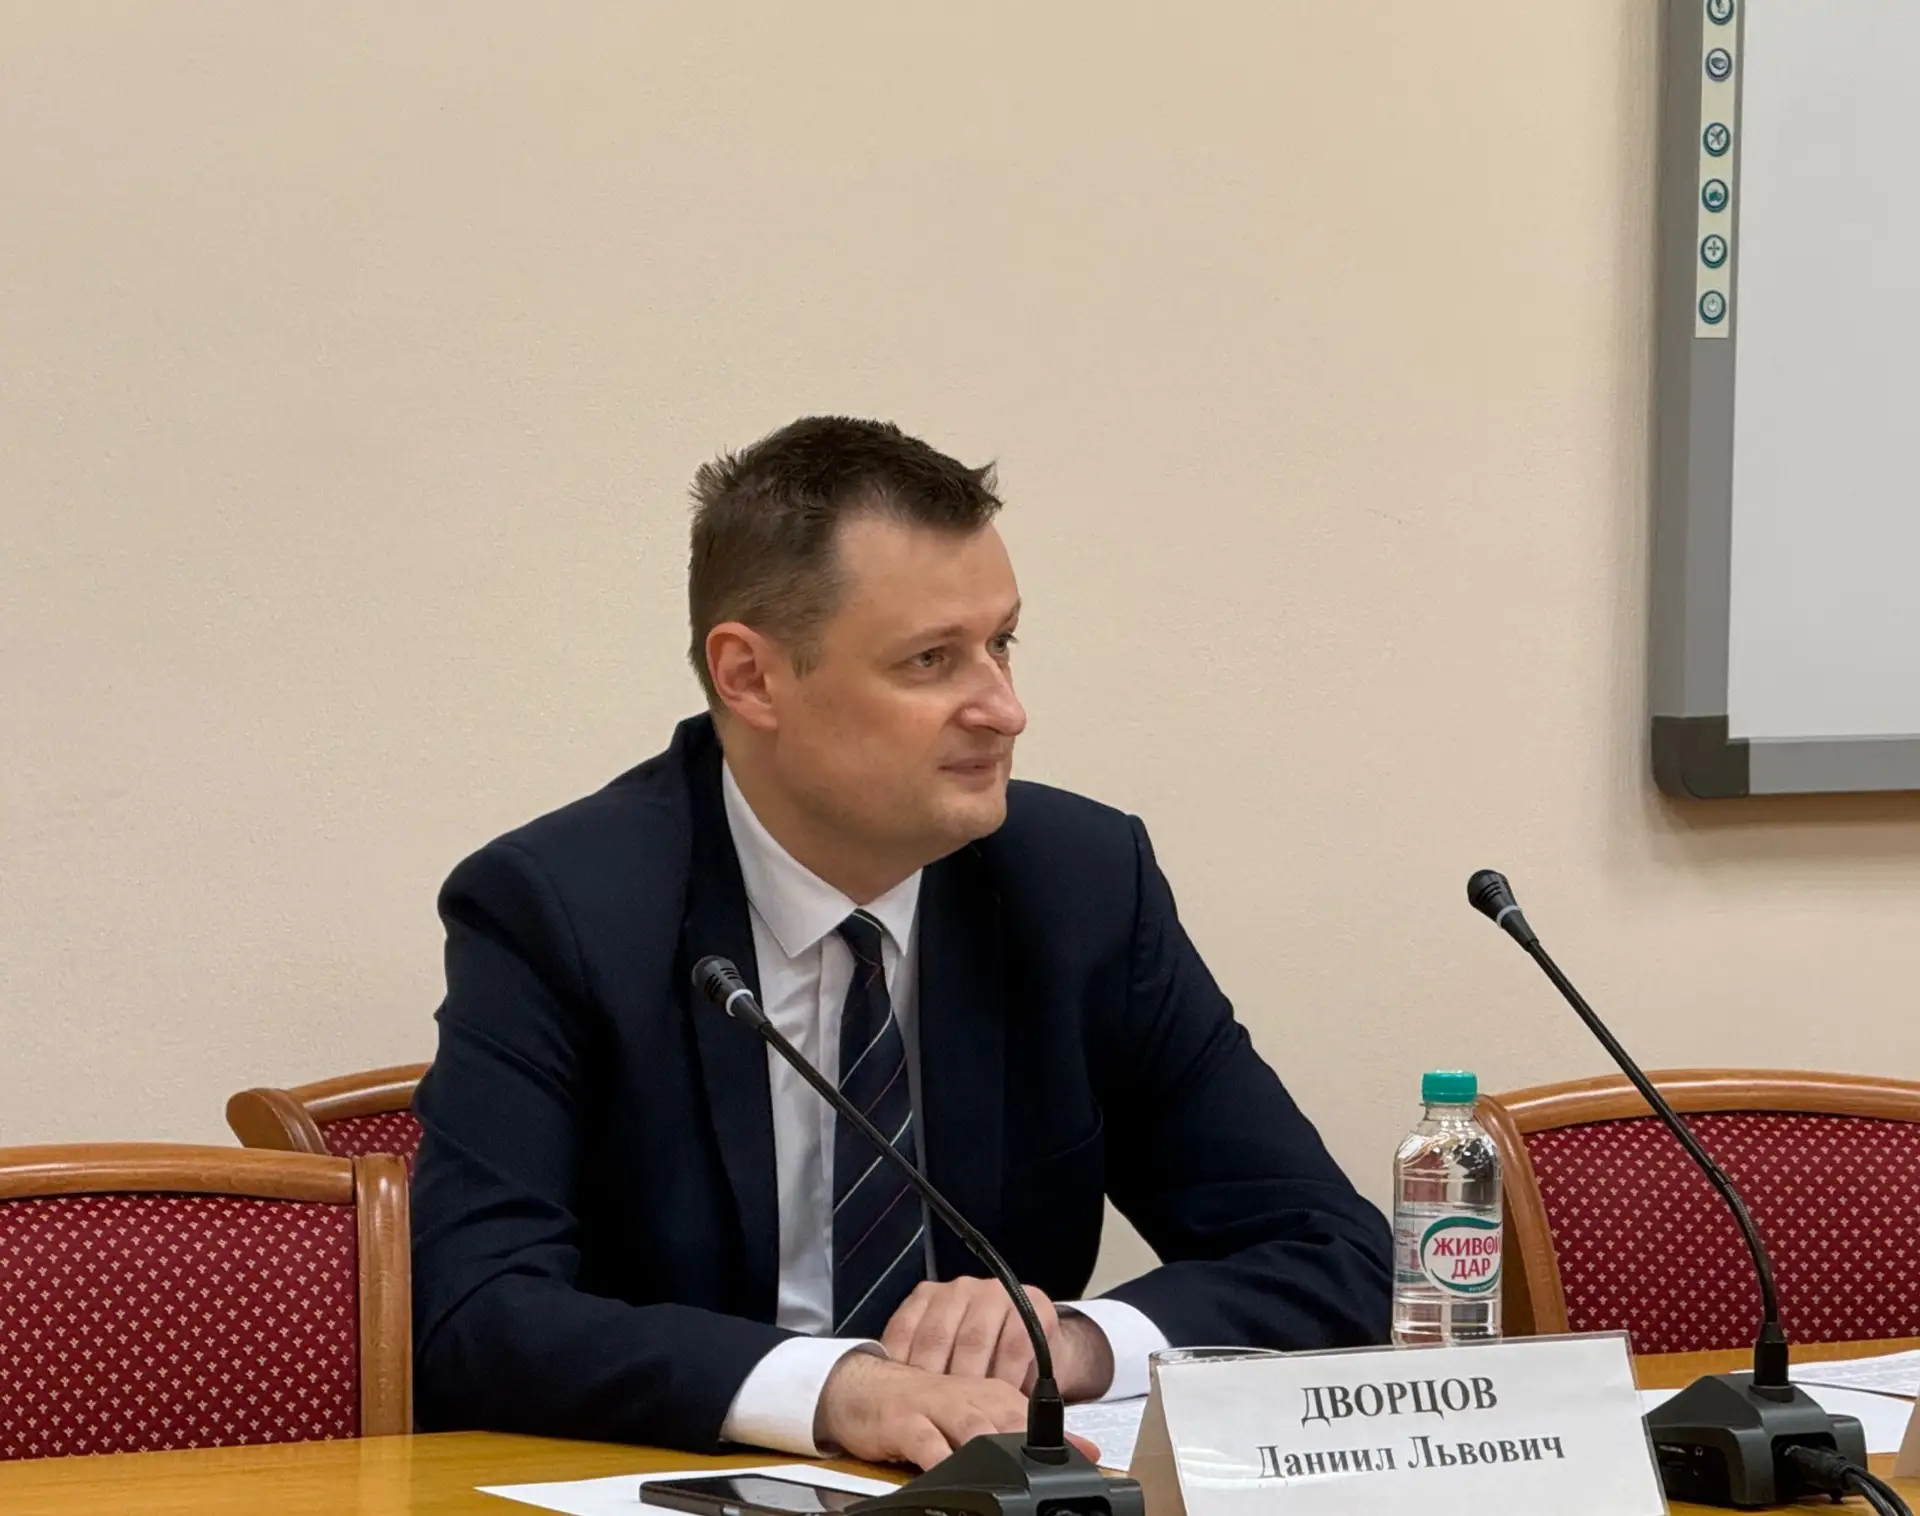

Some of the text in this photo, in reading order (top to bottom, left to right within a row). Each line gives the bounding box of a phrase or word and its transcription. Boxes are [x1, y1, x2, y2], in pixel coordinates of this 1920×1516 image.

[1451, 1258, 1491, 1280] ДАР
[1301, 1376, 1498, 1427] ДВОРЦОВ
[1257, 1435, 1565, 1479] Даниил Львович
